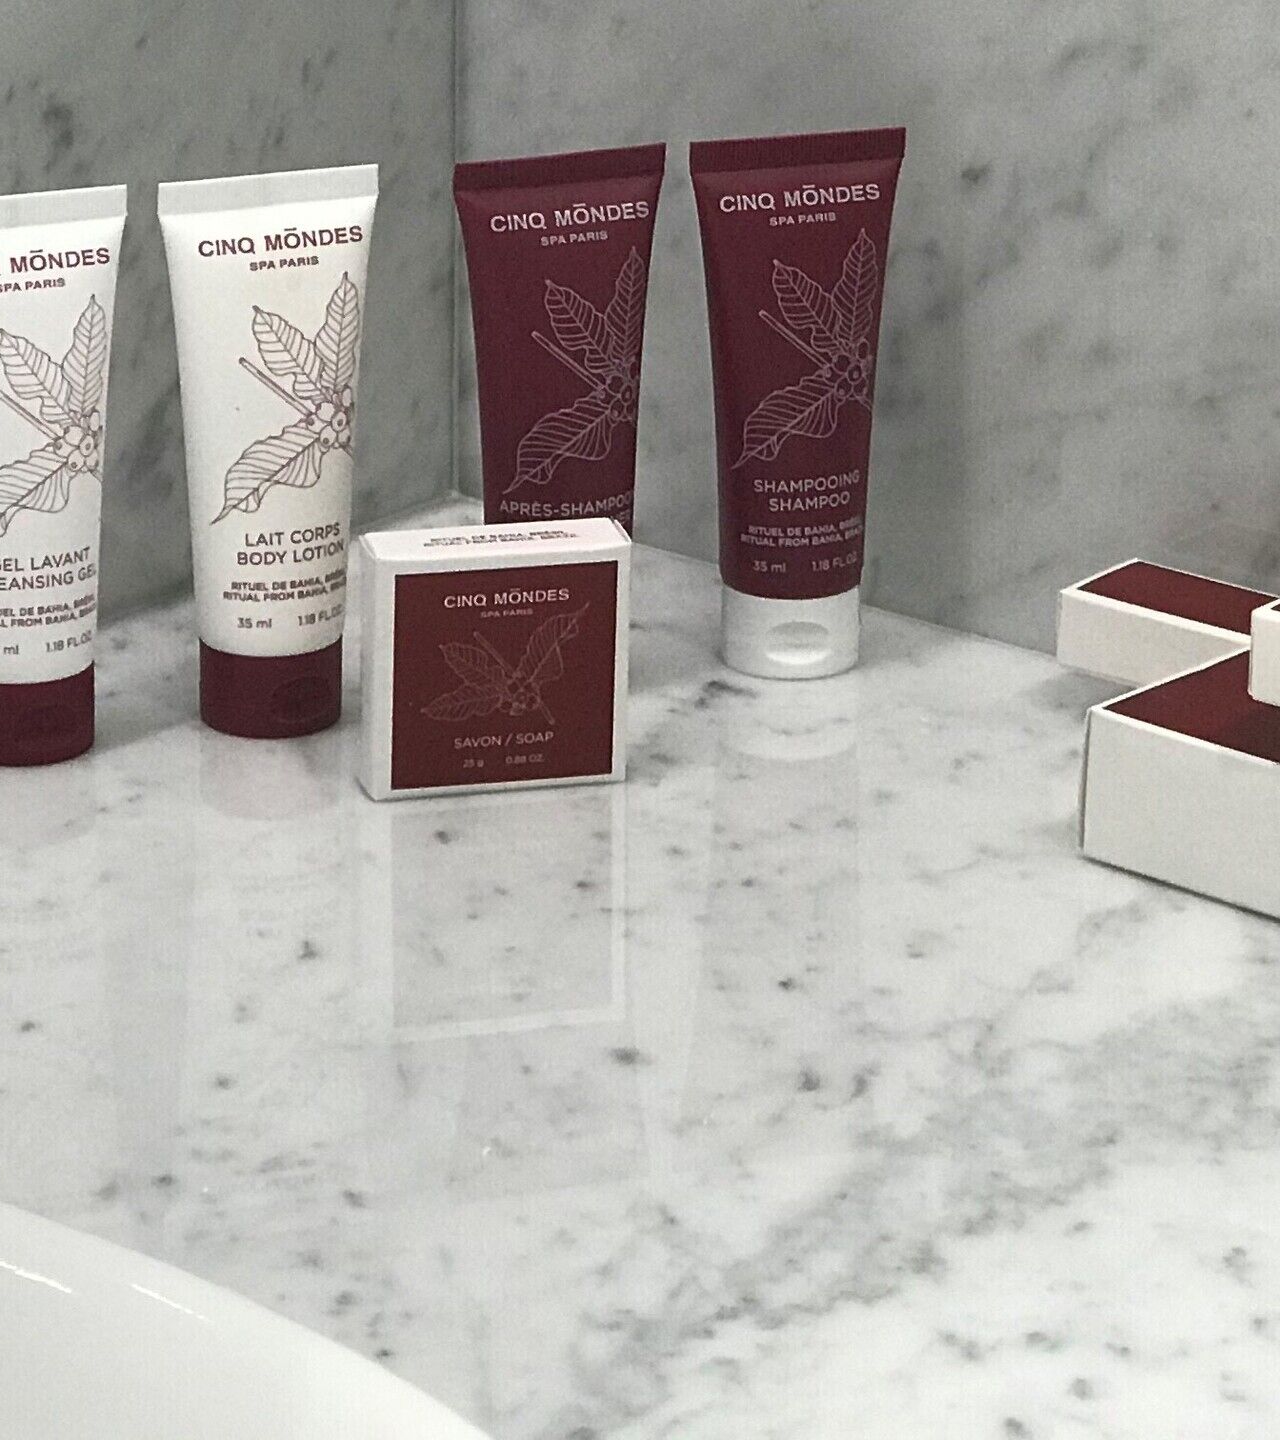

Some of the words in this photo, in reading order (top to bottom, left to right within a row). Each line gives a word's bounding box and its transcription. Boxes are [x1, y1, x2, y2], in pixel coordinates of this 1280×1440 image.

[720, 192, 776, 213] CINQ
[490, 212, 547, 233] CINQ
[769, 215, 795, 227] SPA
[798, 211, 837, 224] PARIS
[198, 236, 256, 257] CINQ
[540, 235, 567, 247] SPA
[570, 230, 608, 243] PARIS
[249, 260, 276, 272] SPA
[280, 255, 319, 268] PARIS
[25, 277, 66, 291] PARIS
[753, 469, 860, 494] SHAMPOOING
[769, 490, 851, 513] SHAMPOO
[245, 531, 285, 547] LAIT
[290, 522, 340, 545] CORPS
[748, 524, 785, 537] RITUEL
[787, 526, 802, 537] DE
[740, 533, 777, 547] RITUAL
[778, 537, 810, 548] FROM
[31, 546, 91, 571] LAVANT
[236, 550, 288, 566] BODY
[293, 538, 345, 563] LOTION
[752, 560, 768, 573] 35
[771, 562, 786, 573] ml
[231, 580, 269, 592] RITUEL
[272, 580, 287, 591] DE
[223, 591, 261, 602] RITUAL
[263, 591, 295, 602] FROM
[444, 593, 487, 609] CINQ
[19, 606, 35, 617] DE
[481, 609, 500, 618] SPA
[503, 607, 533, 616] PARIS
[10, 617, 43, 627] FROM
[236, 617, 253, 629] 35
[255, 618, 273, 629] ml
[3, 644, 20, 656] ml
[454, 735, 502, 750] SAVON
[516, 731, 554, 745] SOAP
